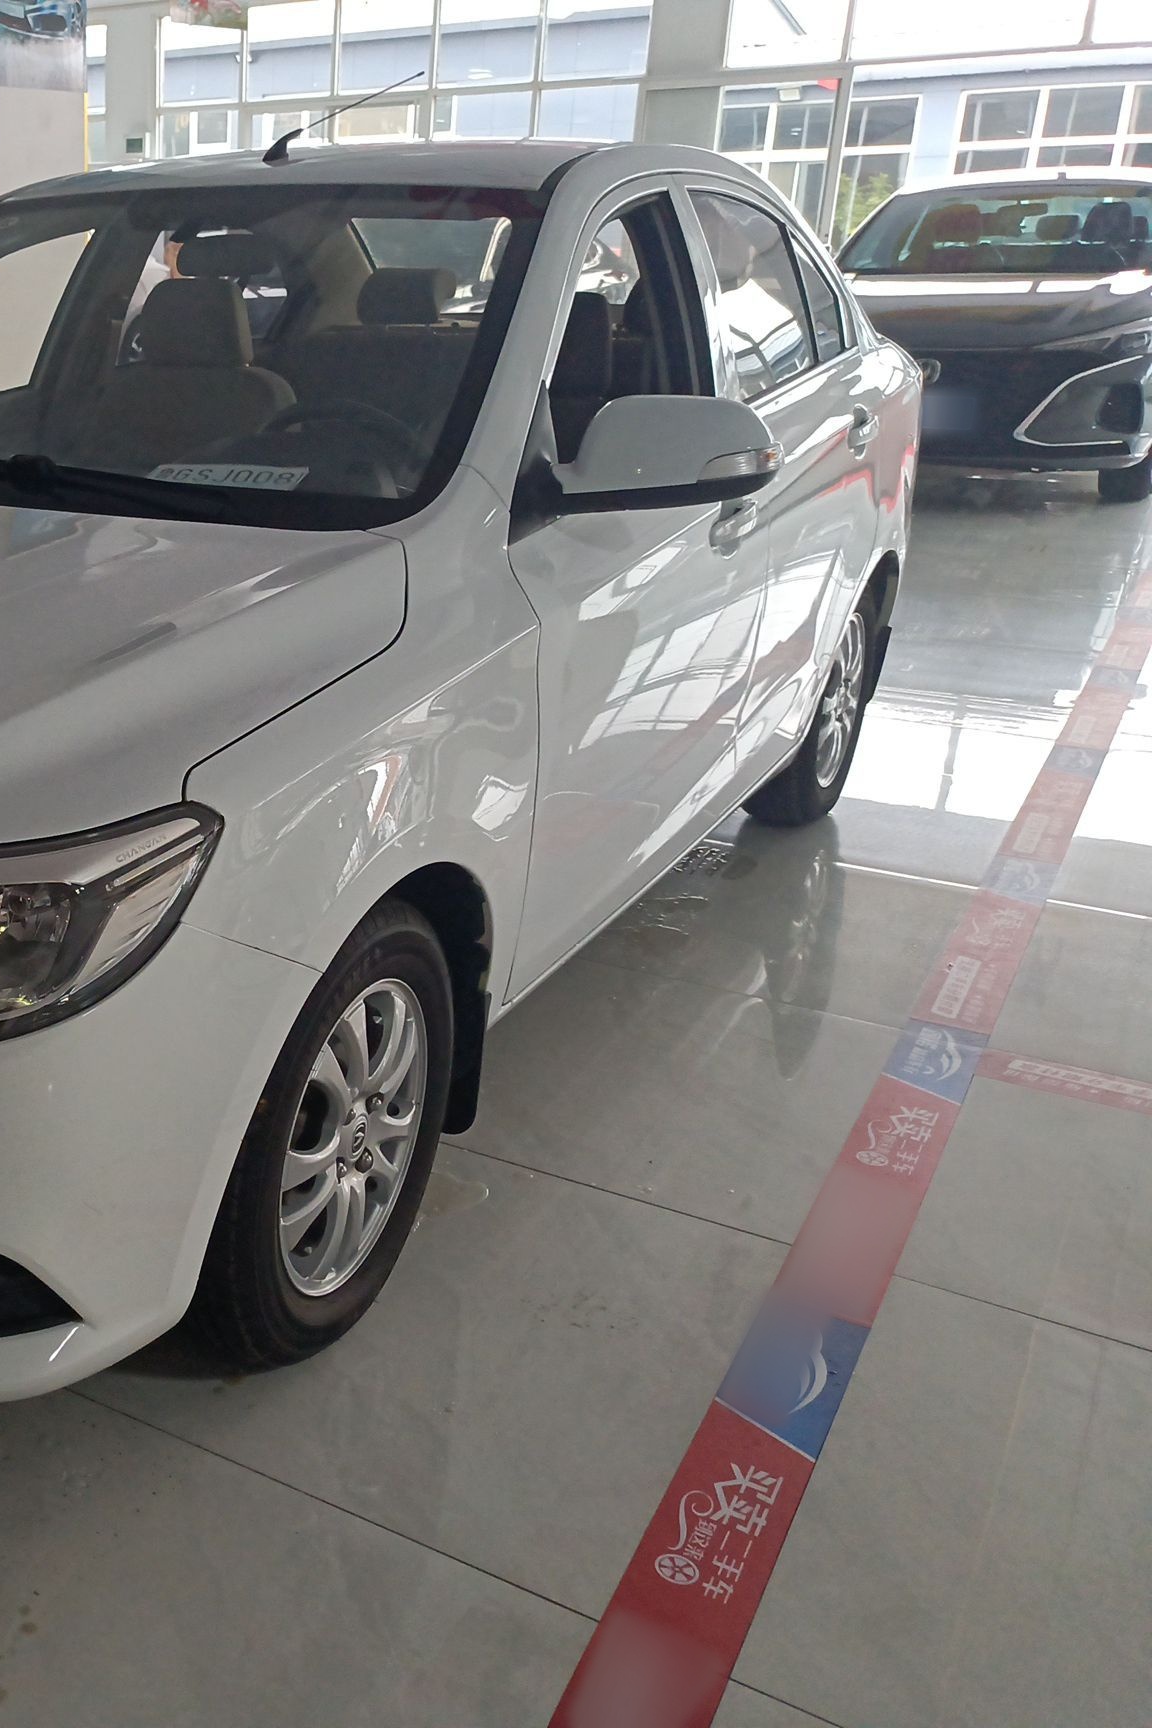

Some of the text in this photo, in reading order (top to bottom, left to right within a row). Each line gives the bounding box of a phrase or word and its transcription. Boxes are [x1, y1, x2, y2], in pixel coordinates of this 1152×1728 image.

[890, 1105, 940, 1176] 买卖二手车
[702, 1462, 784, 1604] 买卖二手车
